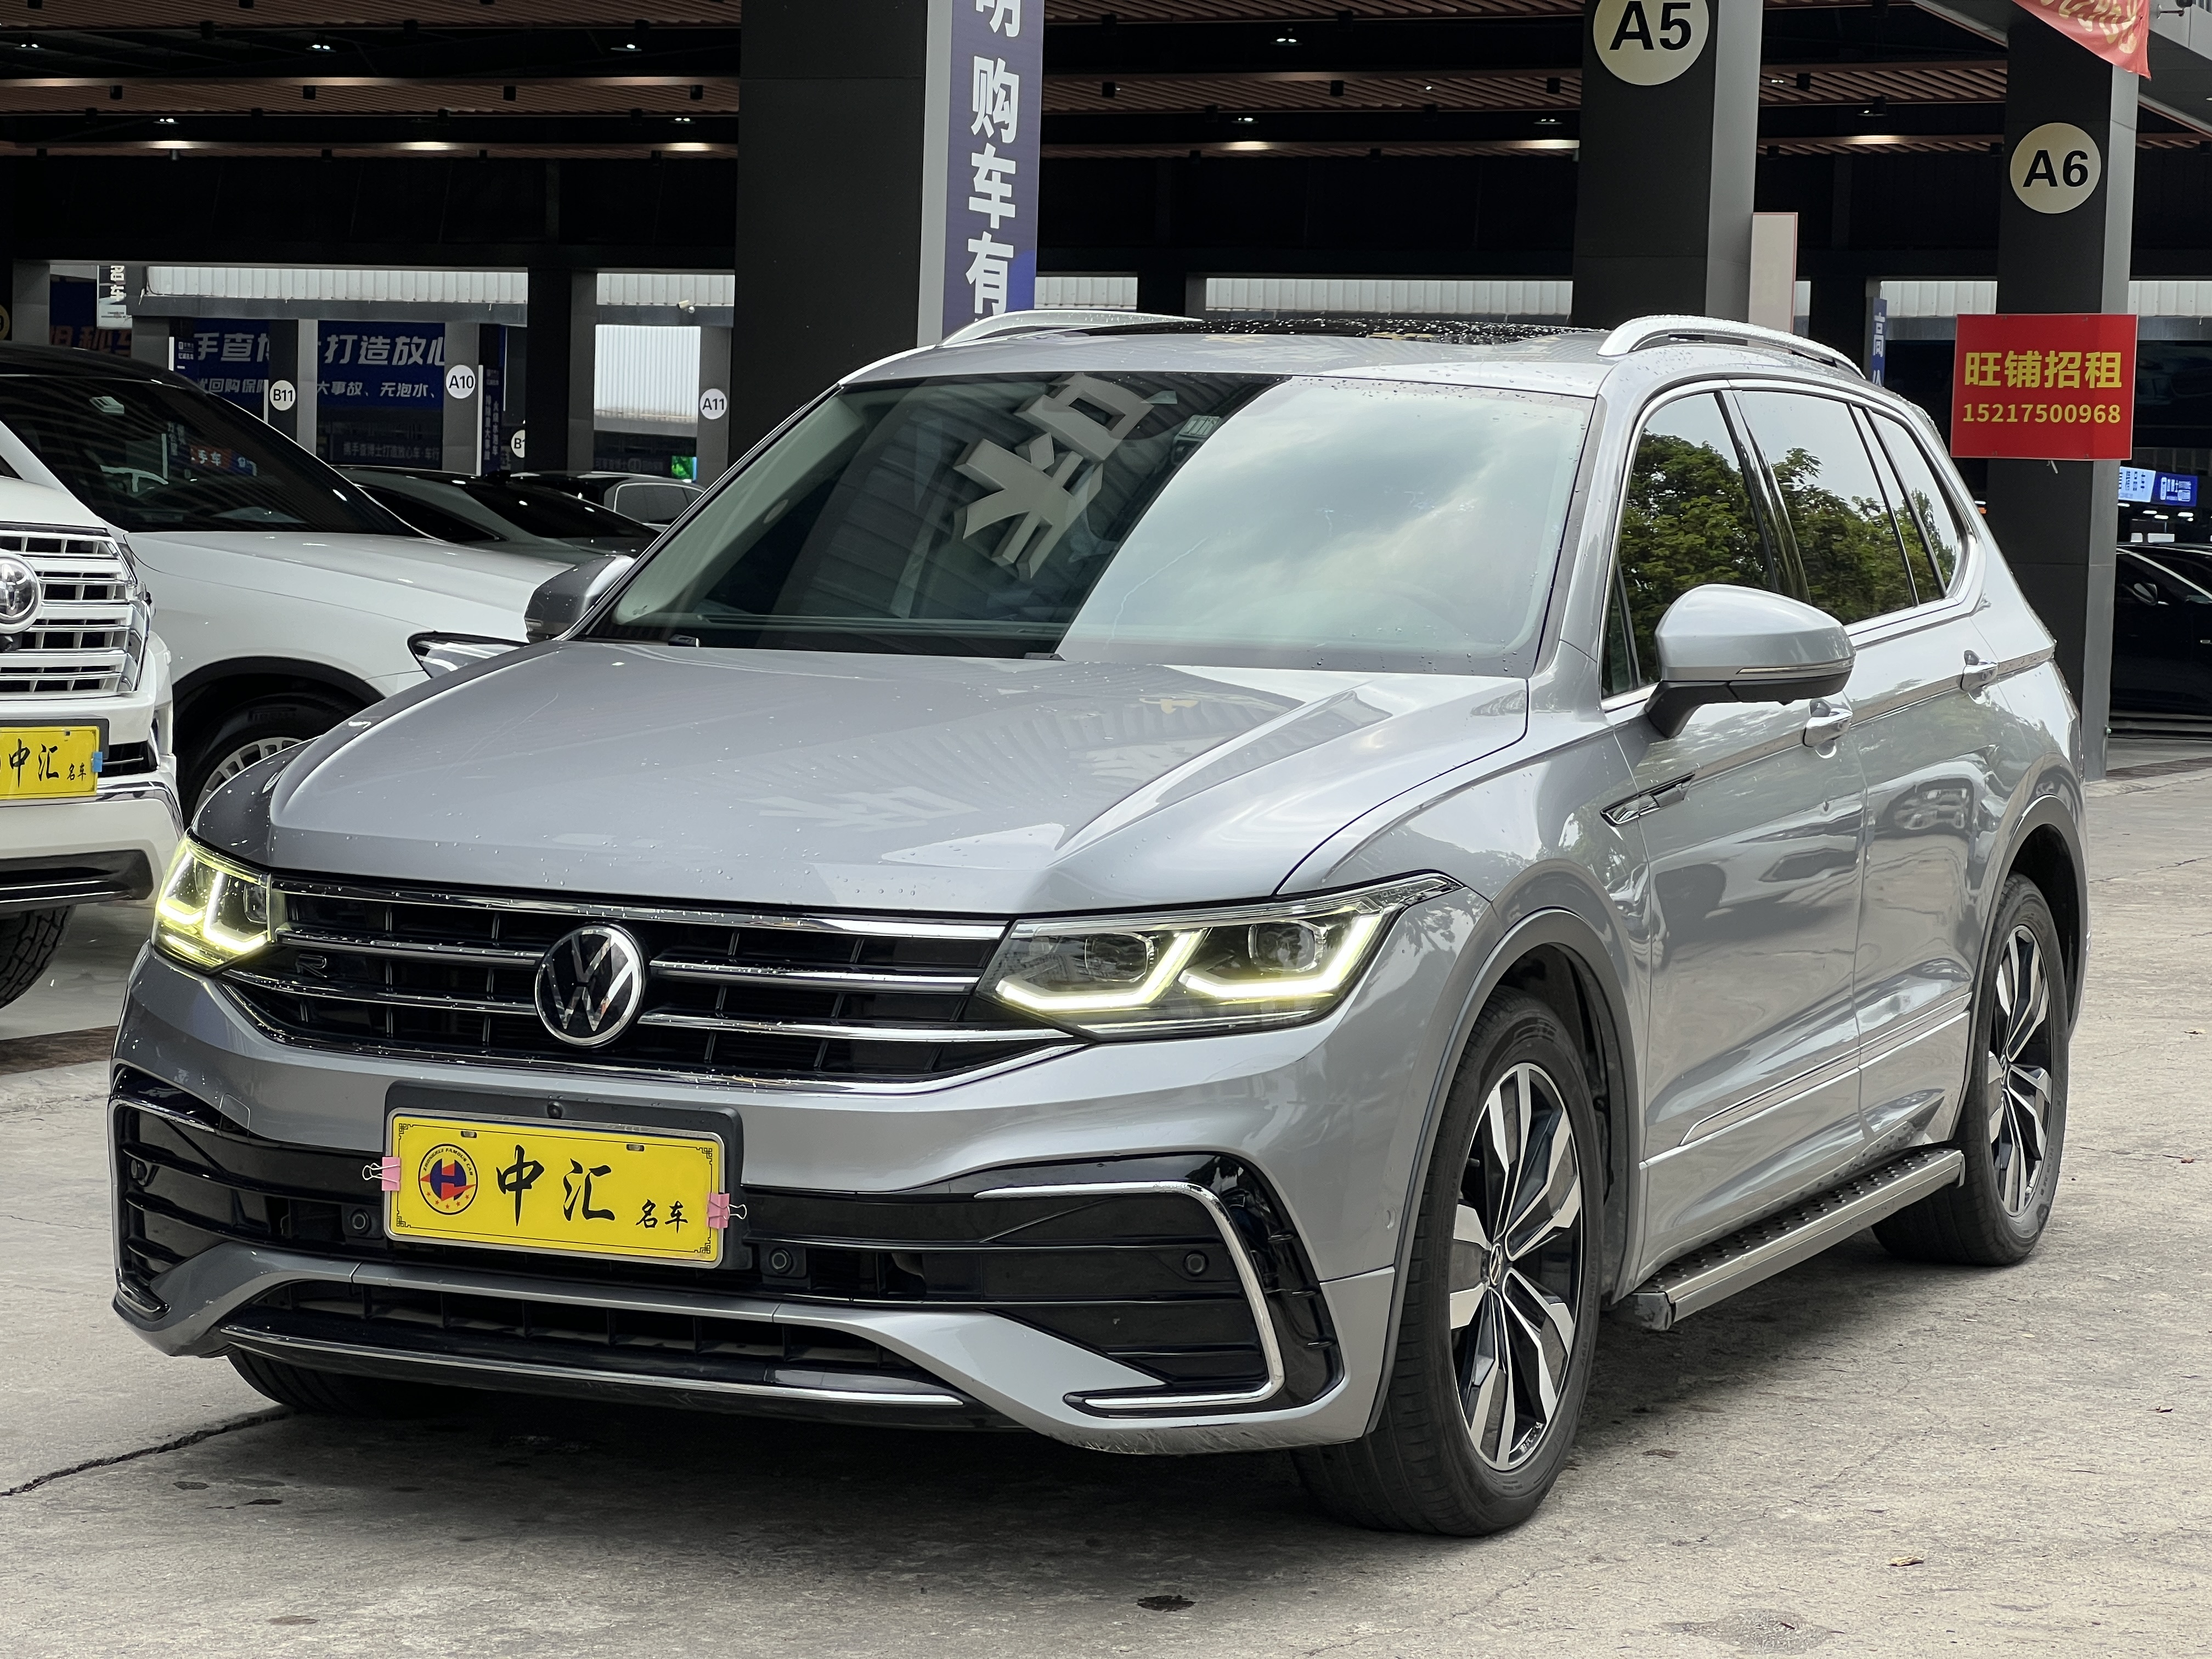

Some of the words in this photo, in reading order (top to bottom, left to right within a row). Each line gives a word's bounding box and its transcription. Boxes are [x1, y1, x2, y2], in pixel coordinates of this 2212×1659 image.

[1609, 1, 1691, 50] A5
[2023, 150, 2089, 188] A6
[448, 374, 475, 389] A10
[1964, 350, 2122, 388] 旺铺招租
[273, 388, 293, 402] B11
[702, 397, 725, 411] A11
[1962, 403, 2121, 424] 15217500968
[9, 738, 59, 788] 中汇
[66, 762, 87, 781] 名车
[495, 1144, 616, 1227] 中汇
[635, 1199, 689, 1234] 名车
